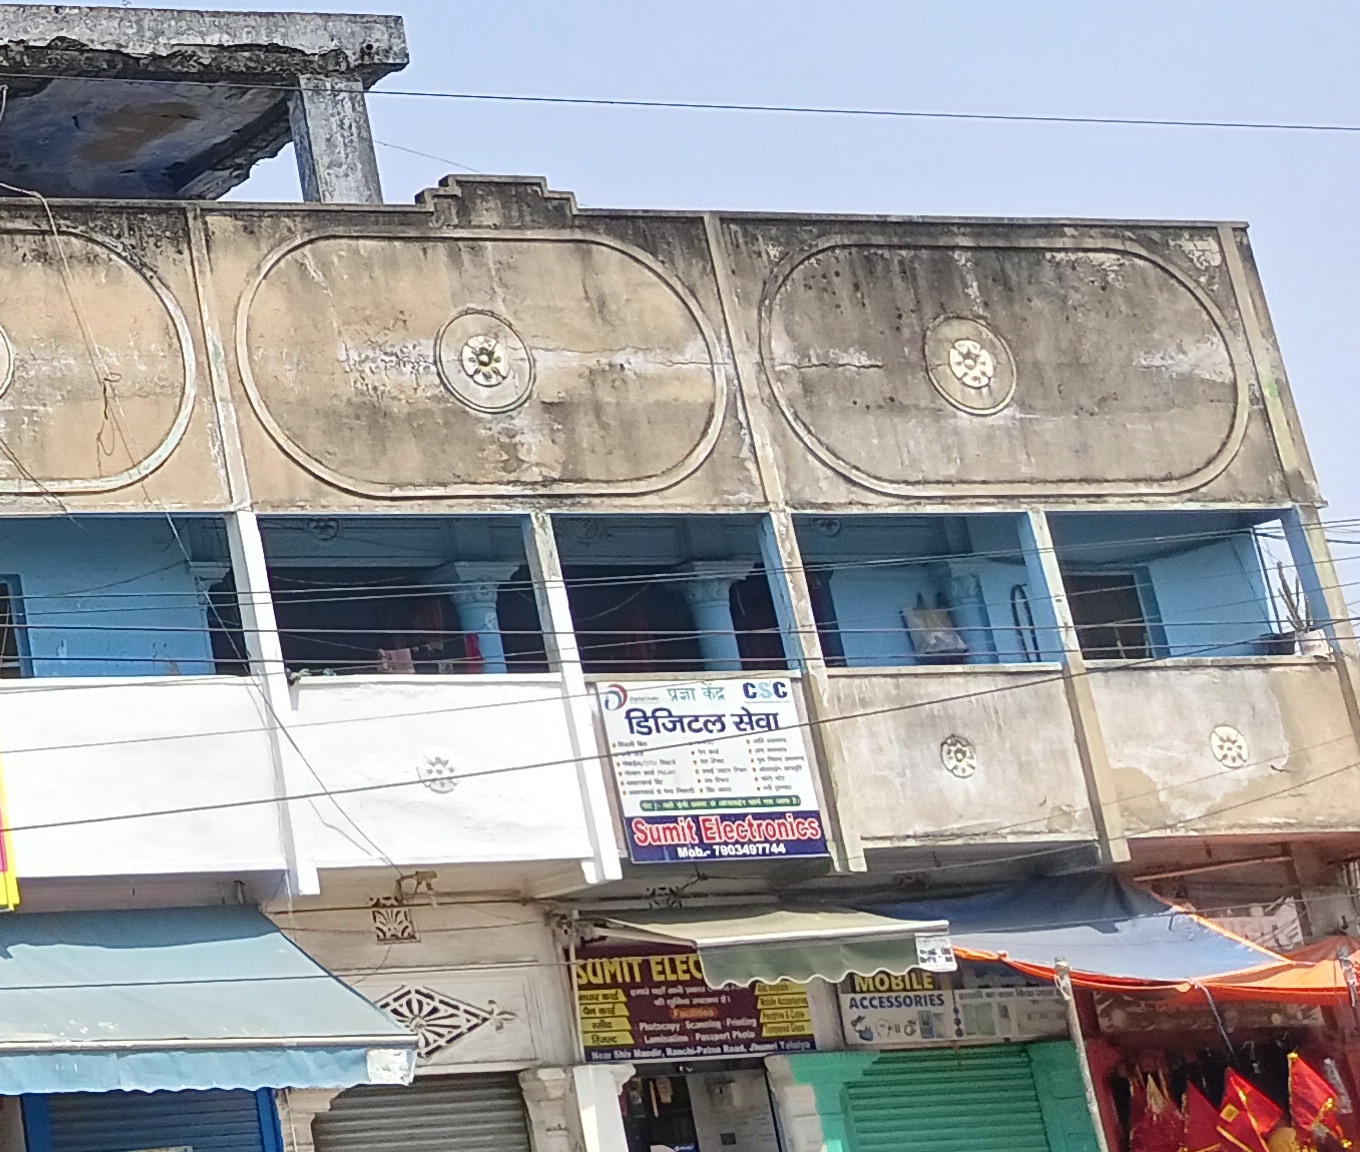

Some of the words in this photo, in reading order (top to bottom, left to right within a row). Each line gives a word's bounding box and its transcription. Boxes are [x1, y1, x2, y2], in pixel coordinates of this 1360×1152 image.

[667, 688, 696, 701] प्रज्ञा
[701, 682, 725, 700] केंद्र
[742, 681, 788, 699] CSC
[624, 708, 726, 735] डिजिटल
[730, 707, 779, 731] सेवा
[632, 818, 699, 846] Sumit
[699, 813, 821, 843] Electronics
[577, 958, 642, 984] SUMIT
[855, 974, 934, 992] MOBILE
[849, 994, 945, 1009] ACCESSORIES
